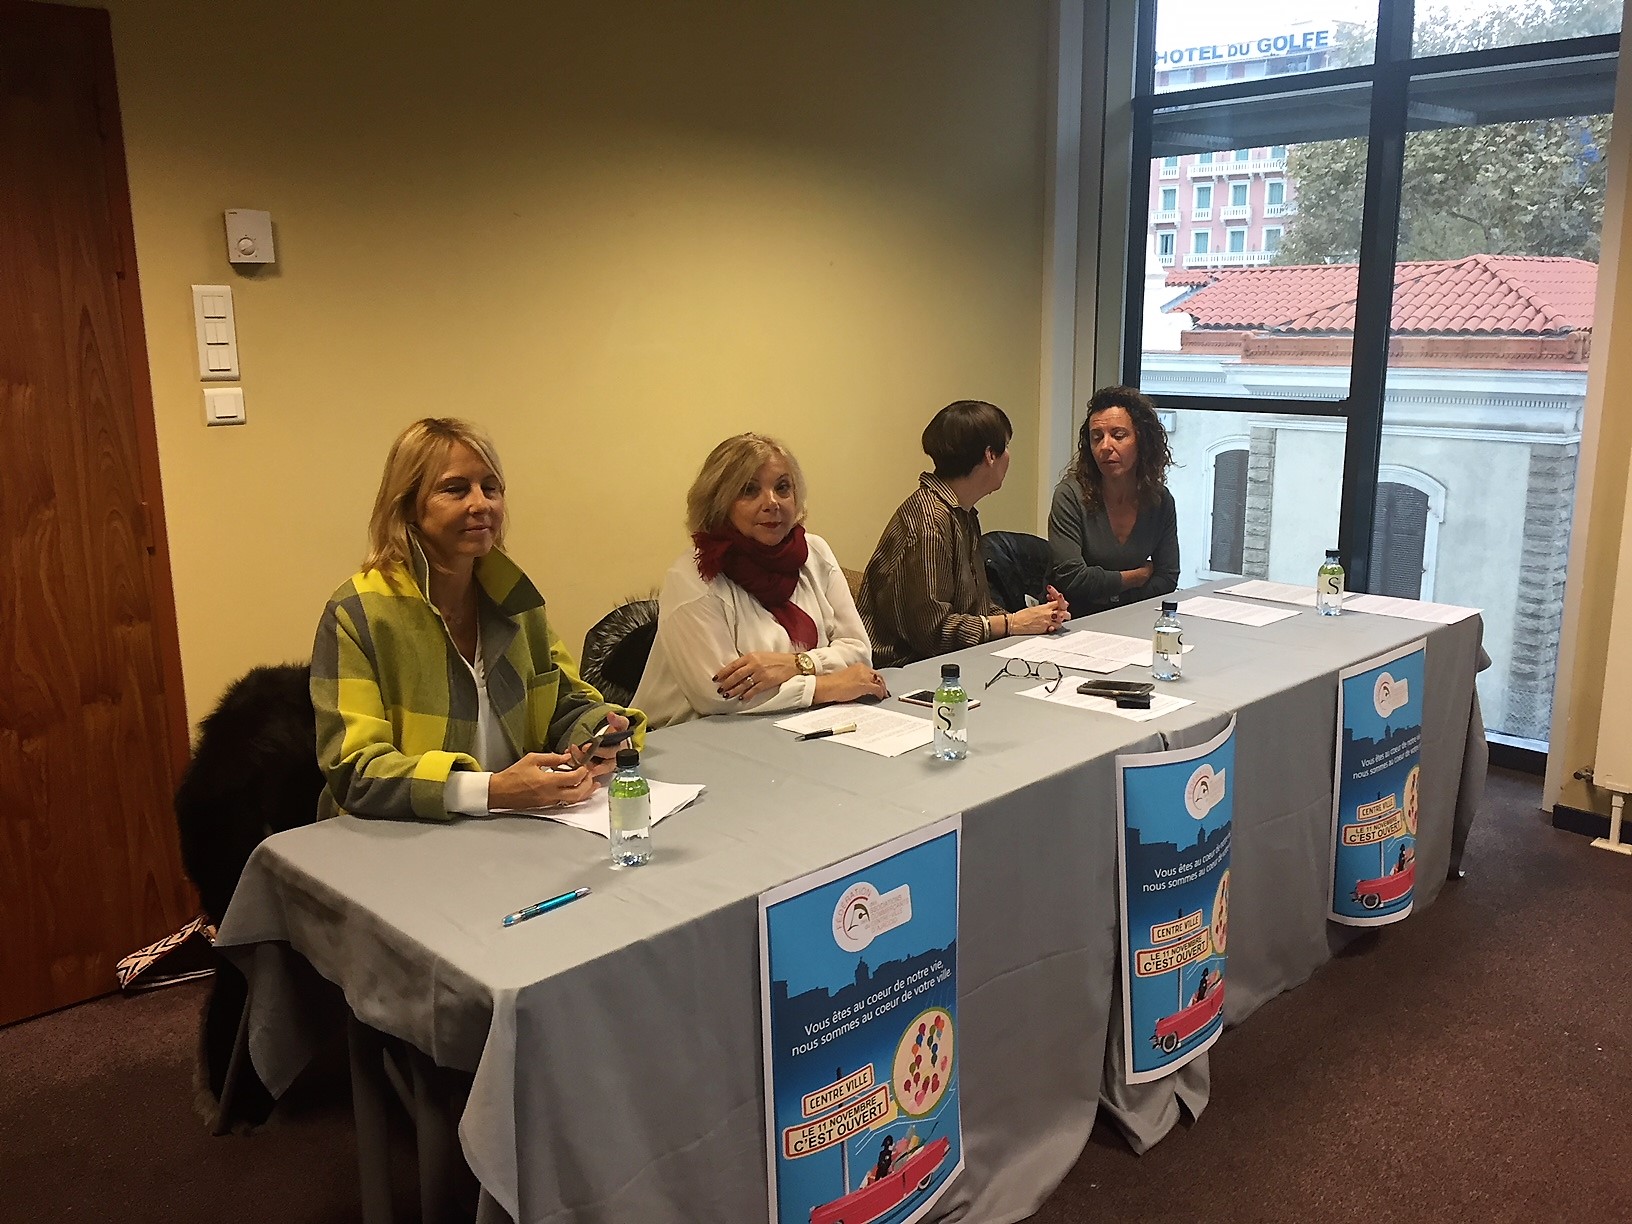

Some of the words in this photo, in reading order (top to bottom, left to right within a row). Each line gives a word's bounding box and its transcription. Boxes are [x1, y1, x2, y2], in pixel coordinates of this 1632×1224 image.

[1155, 45, 1223, 65] HOTEL
[1227, 44, 1250, 58] DU
[1257, 31, 1328, 53] GOLFE
[1362, 804, 1382, 816] CENTRE
[1349, 830, 1376, 842] C'EST
[1377, 820, 1400, 837] OUVERT
[1143, 882, 1166, 892] nous
[1168, 871, 1197, 888] sommes
[1154, 868, 1177, 878] Vous
[1178, 863, 1193, 874] êtes
[1157, 923, 1183, 938] CENTRE
[1184, 916, 1199, 930] VILLE
[1143, 957, 1174, 972] C'EST
[1176, 941, 1206, 962] OUVERT
[1150, 952, 1161, 961] LE
[1162, 950, 1171, 958] 11
[1171, 935, 1202, 955] NOVEMBRE
[804, 1017, 831, 1037] Vous
[832, 1005, 852, 1024] êtes
[853, 1000, 866, 1014] au
[866, 987, 894, 1007] coeur
[893, 979, 906, 993] de
[906, 967, 930, 987] notre
[930, 959, 945, 974] vie,
[791, 1037, 820, 1058] nous
[820, 1018, 861, 1046] sommes
[861, 1012, 874, 1026] au
[874, 998, 901, 1018] coeur
[901, 989, 914, 1004] de
[913, 978, 937, 996] votre
[809, 1085, 844, 1111] CENTRE
[845, 1072, 868, 1093] VILLE
[793, 1129, 834, 1153] C'EST
[836, 1102, 884, 1136] OUVERT
[801, 1126, 815, 1139] LE
[817, 1122, 827, 1133] 11
[828, 1095, 877, 1128] NOVEMBRE
